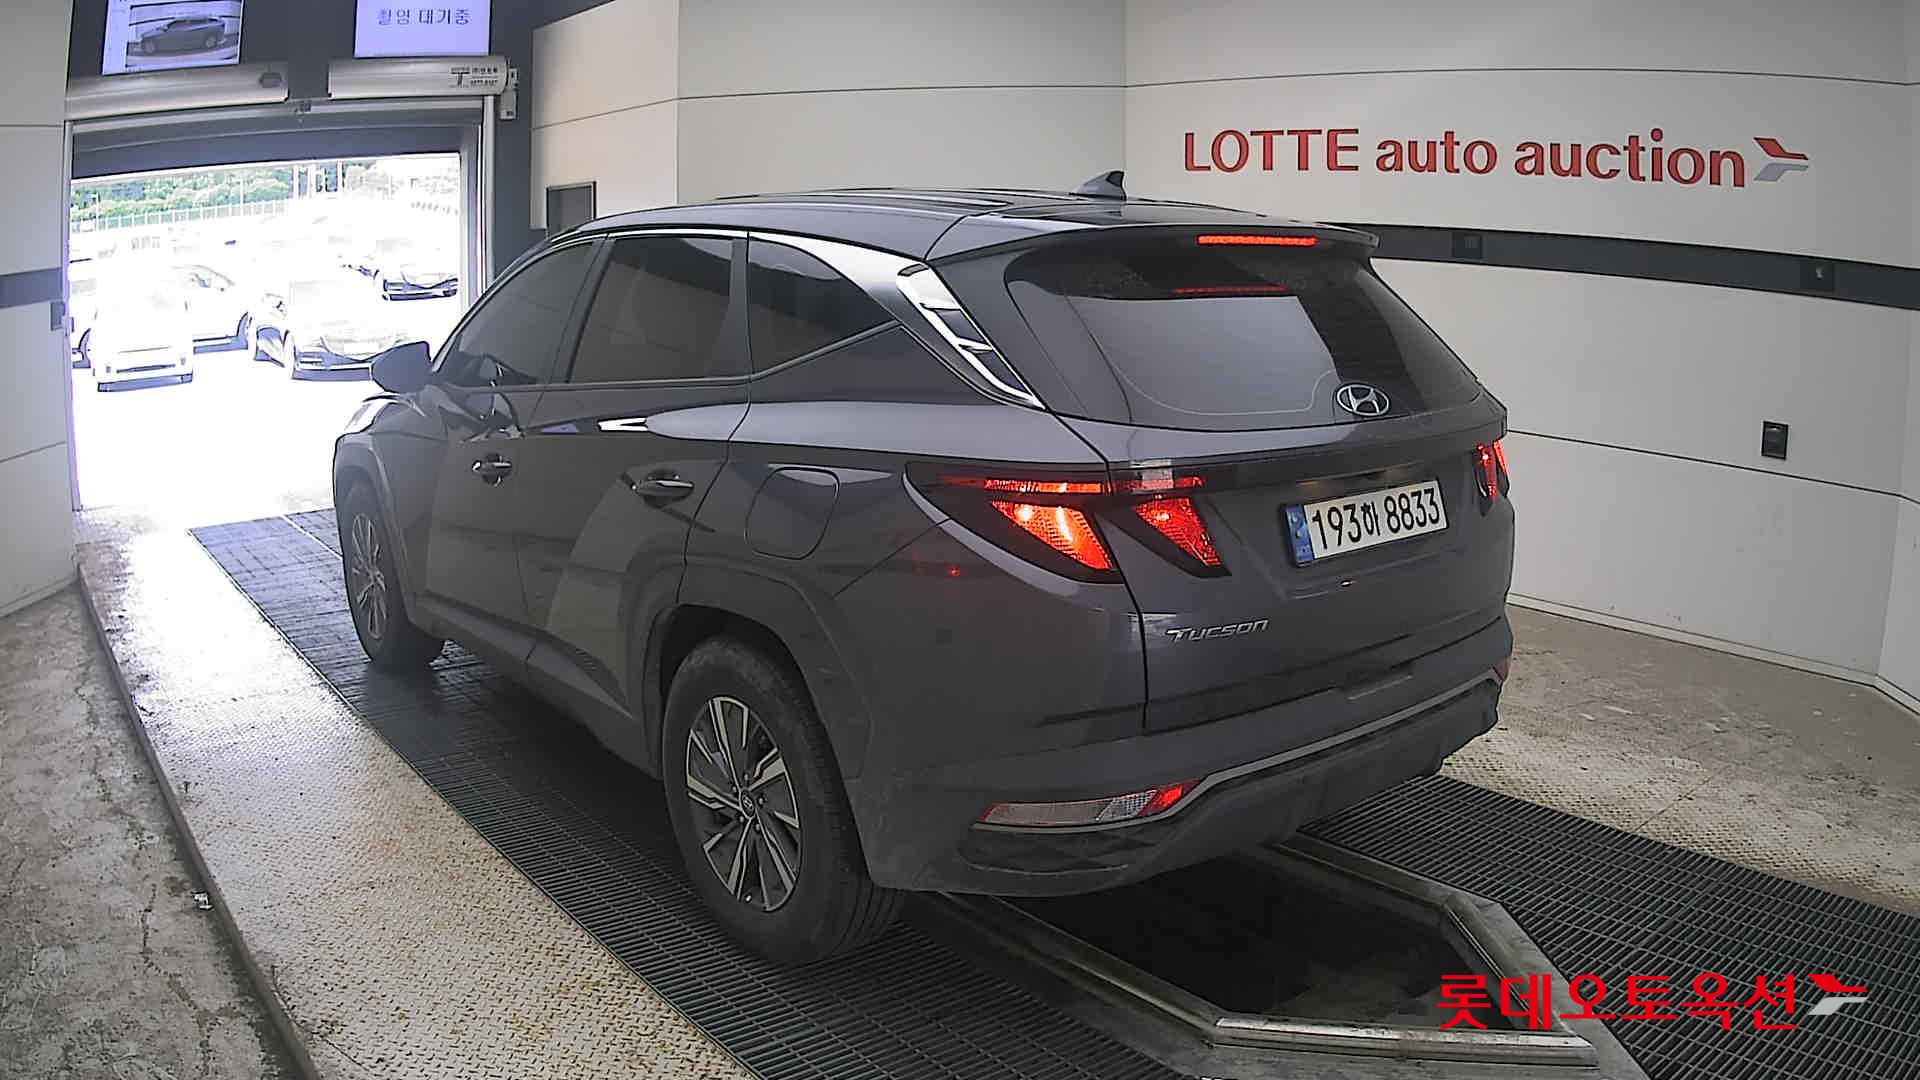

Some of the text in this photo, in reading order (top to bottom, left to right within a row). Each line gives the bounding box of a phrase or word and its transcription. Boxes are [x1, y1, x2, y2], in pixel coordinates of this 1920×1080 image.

[418, 8, 469, 25] 대기중
[1184, 128, 1746, 188] LOTTE auto auction
[1311, 486, 1440, 551] 193하 8833
